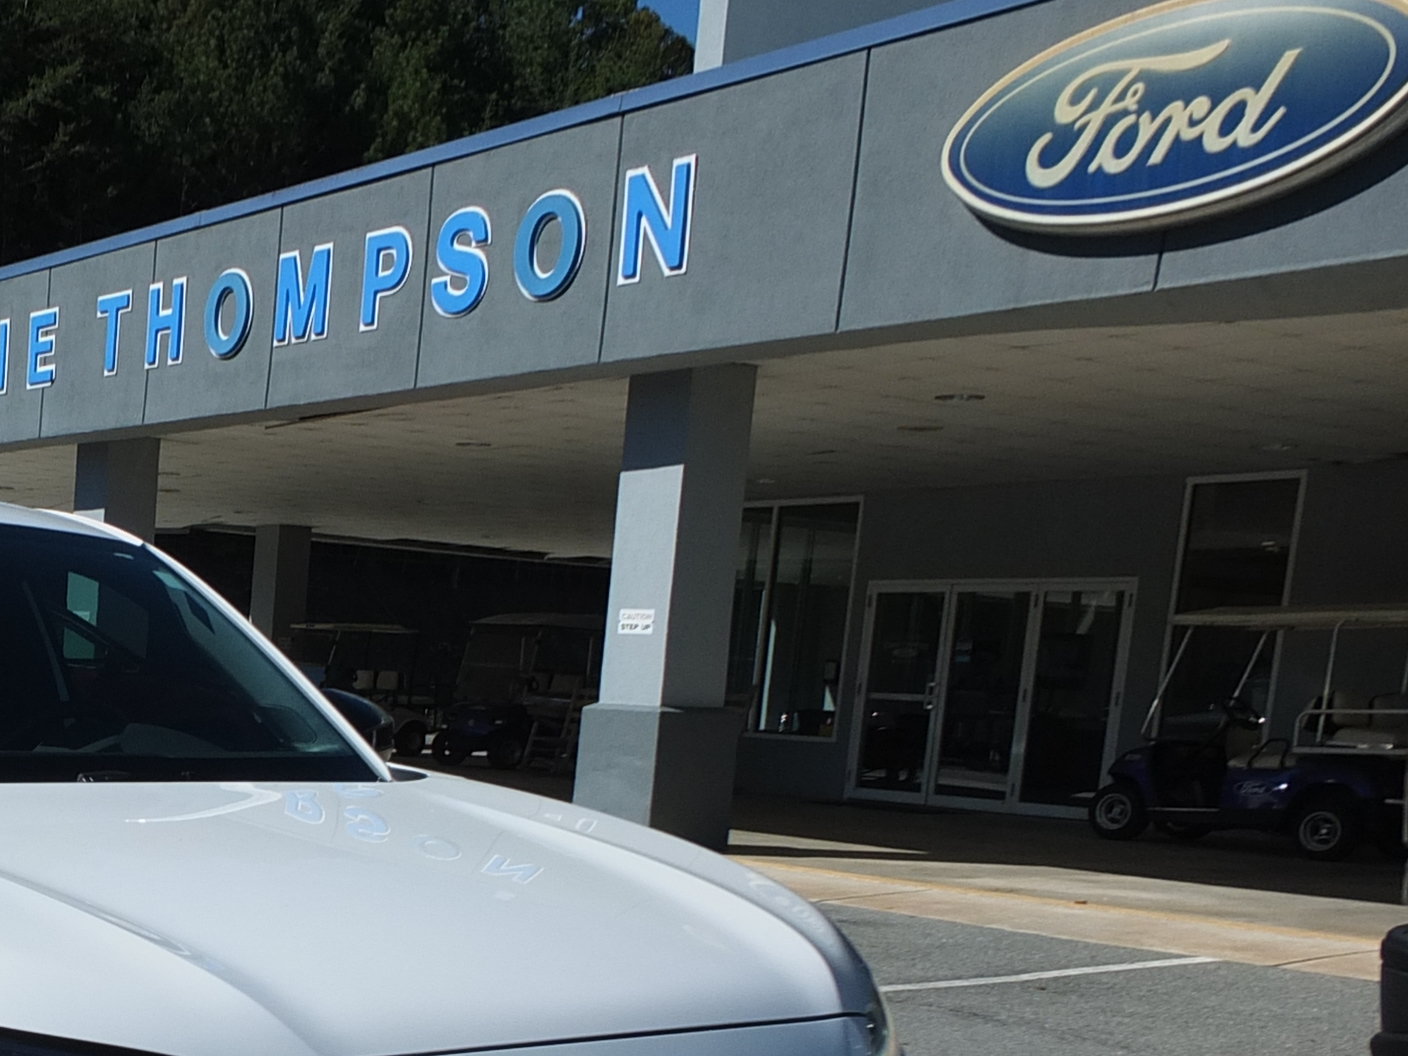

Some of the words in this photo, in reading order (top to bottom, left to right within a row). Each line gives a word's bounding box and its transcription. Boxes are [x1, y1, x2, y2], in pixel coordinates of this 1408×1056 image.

[1024, 38, 1303, 189] Ford
[96, 153, 698, 377] THOMPSON
[620, 623, 640, 631] STEP
[641, 623, 652, 631] UP
